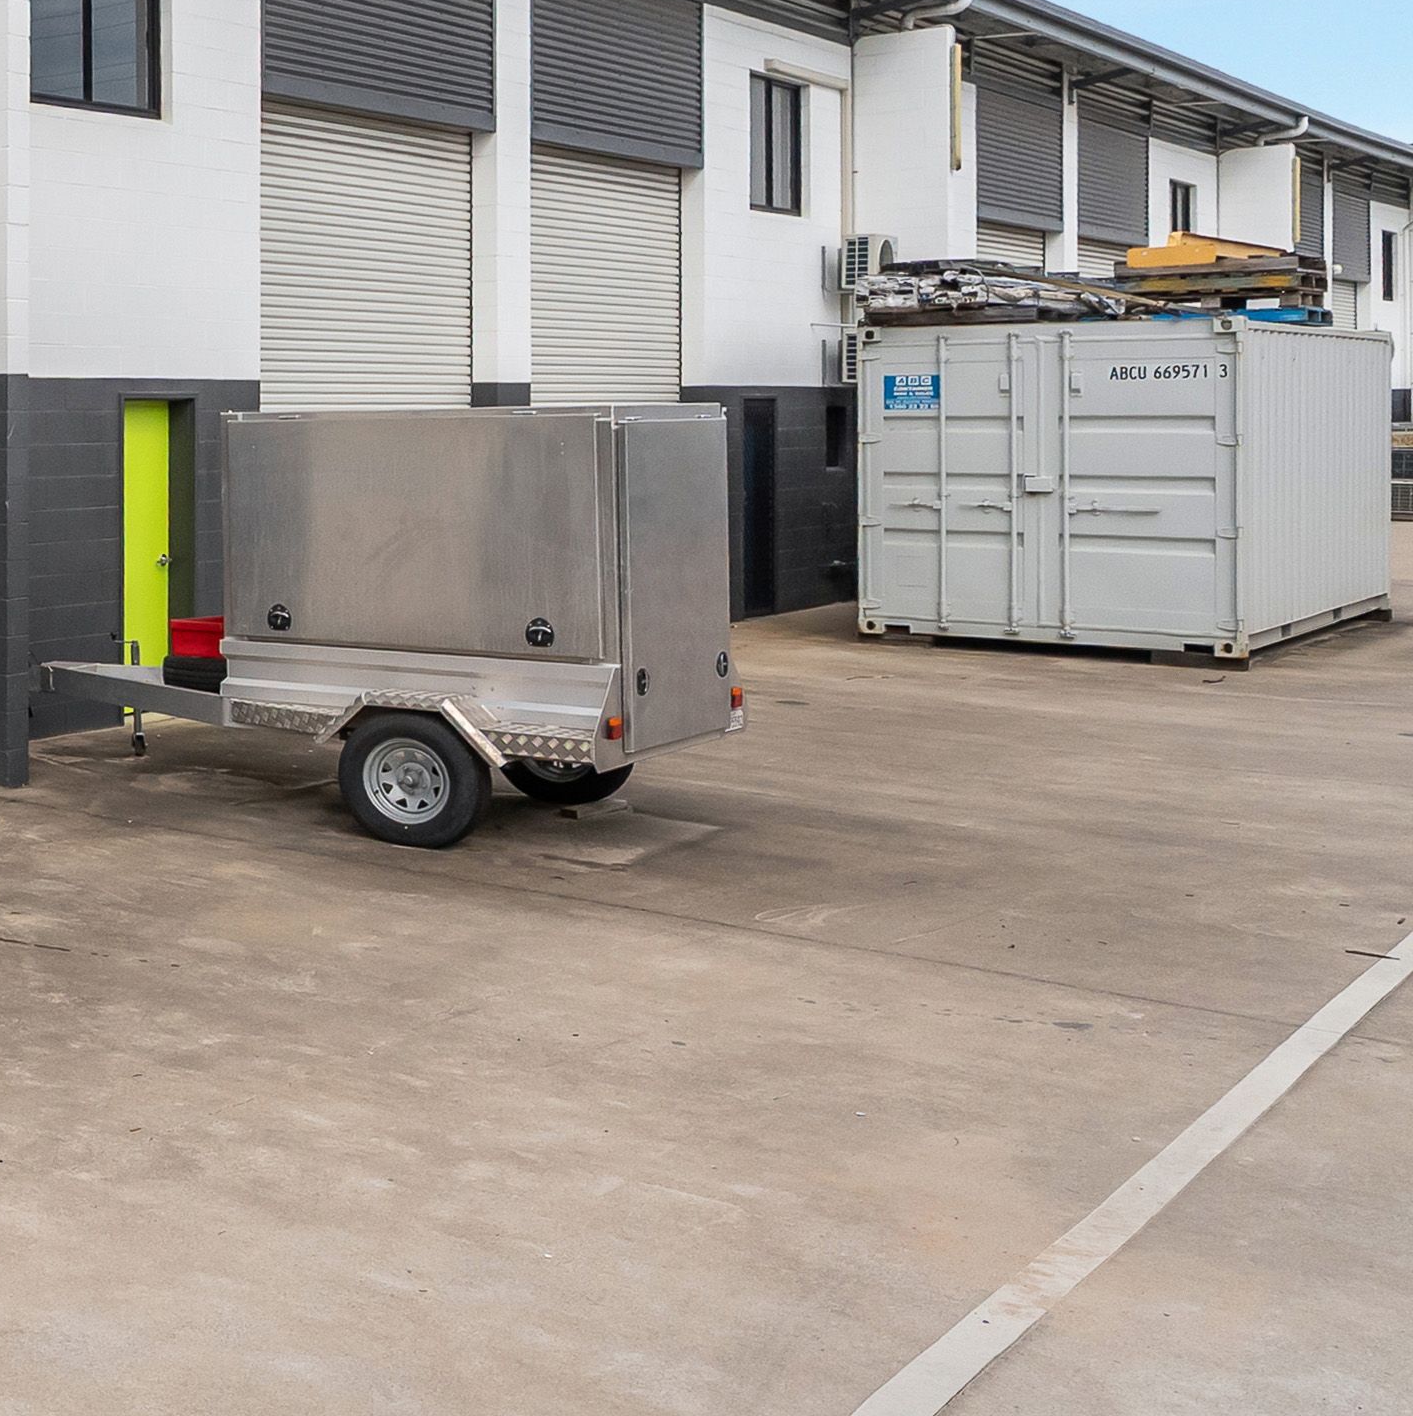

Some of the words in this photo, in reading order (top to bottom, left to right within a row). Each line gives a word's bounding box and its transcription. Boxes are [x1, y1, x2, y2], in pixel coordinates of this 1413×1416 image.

[1109, 366, 1147, 380] ABCU
[1153, 364, 1208, 380] 669571
[1219, 364, 1228, 378] 3
